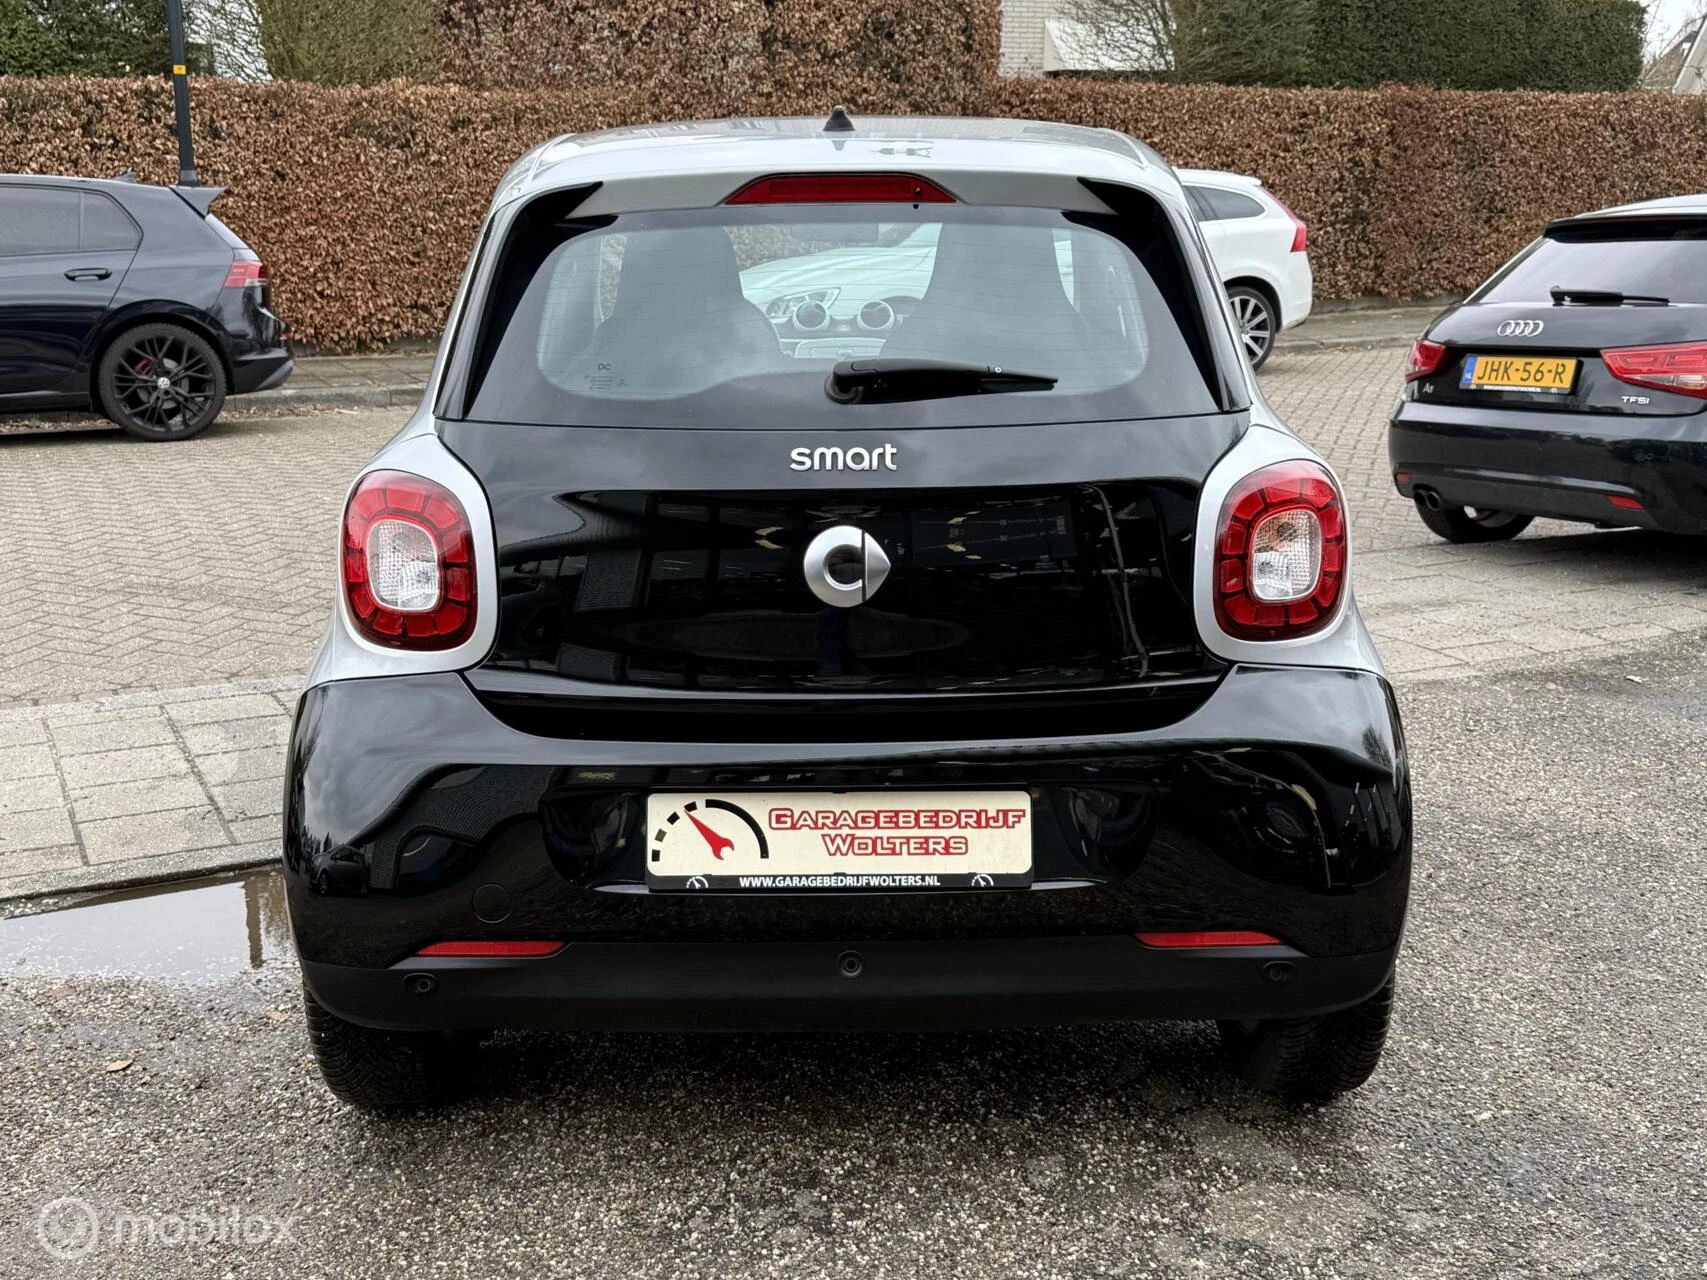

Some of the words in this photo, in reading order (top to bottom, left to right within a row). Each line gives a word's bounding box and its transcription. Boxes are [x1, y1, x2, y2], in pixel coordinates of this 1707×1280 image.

[1477, 360, 1567, 384] JHK-56-R
[1621, 396, 1650, 405] TFSI
[789, 443, 898, 471] smart
[769, 808, 1026, 830] GARAGEBEDRIJF
[821, 834, 968, 856] WOLTERS
[739, 875, 941, 888] WWW.GARAGEBEDRIJFWOLTERS.NL
